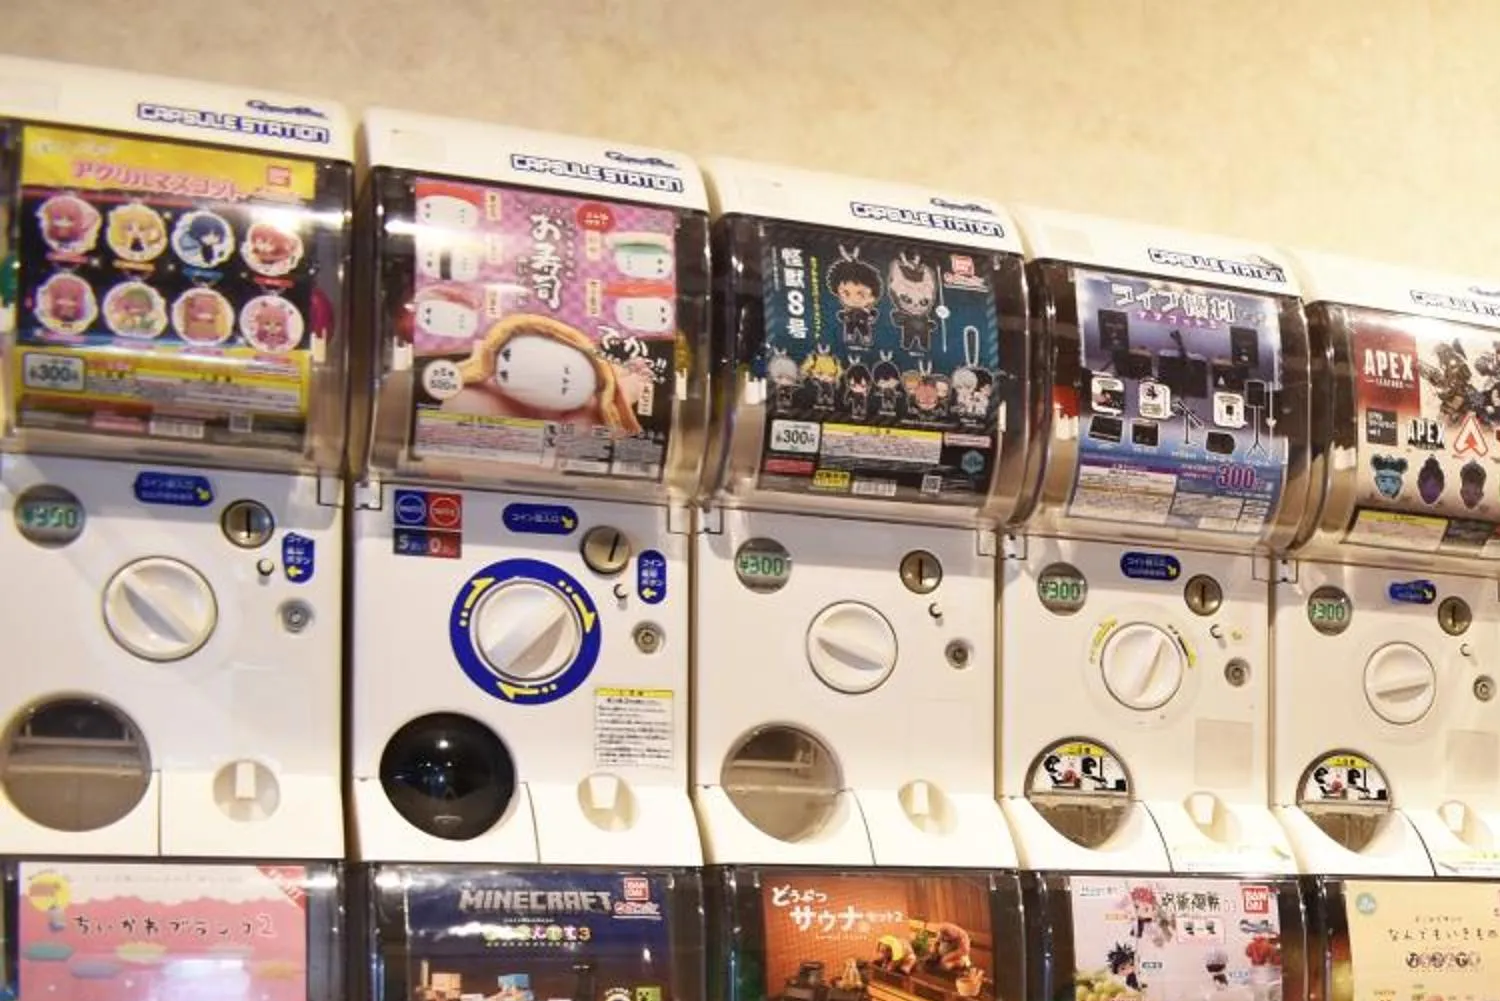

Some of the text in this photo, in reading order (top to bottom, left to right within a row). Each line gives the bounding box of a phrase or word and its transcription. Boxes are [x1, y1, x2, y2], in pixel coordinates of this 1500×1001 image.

[138, 102, 329, 143] CAPSULE STATION
[511, 154, 601, 180] CAPSULE
[600, 164, 684, 192] STATION
[851, 201, 930, 228] CAPSULE
[929, 211, 1004, 239] STATION
[1149, 247, 1286, 283] CAPSULE STATION
[1364, 348, 1413, 381] APEX
[1408, 419, 1444, 444] APEX
[740, 556, 784, 577] ¥300
[1041, 580, 1082, 600] ¥300
[459, 888, 612, 912] MINECRAFT
[789, 904, 863, 932] サウナ
